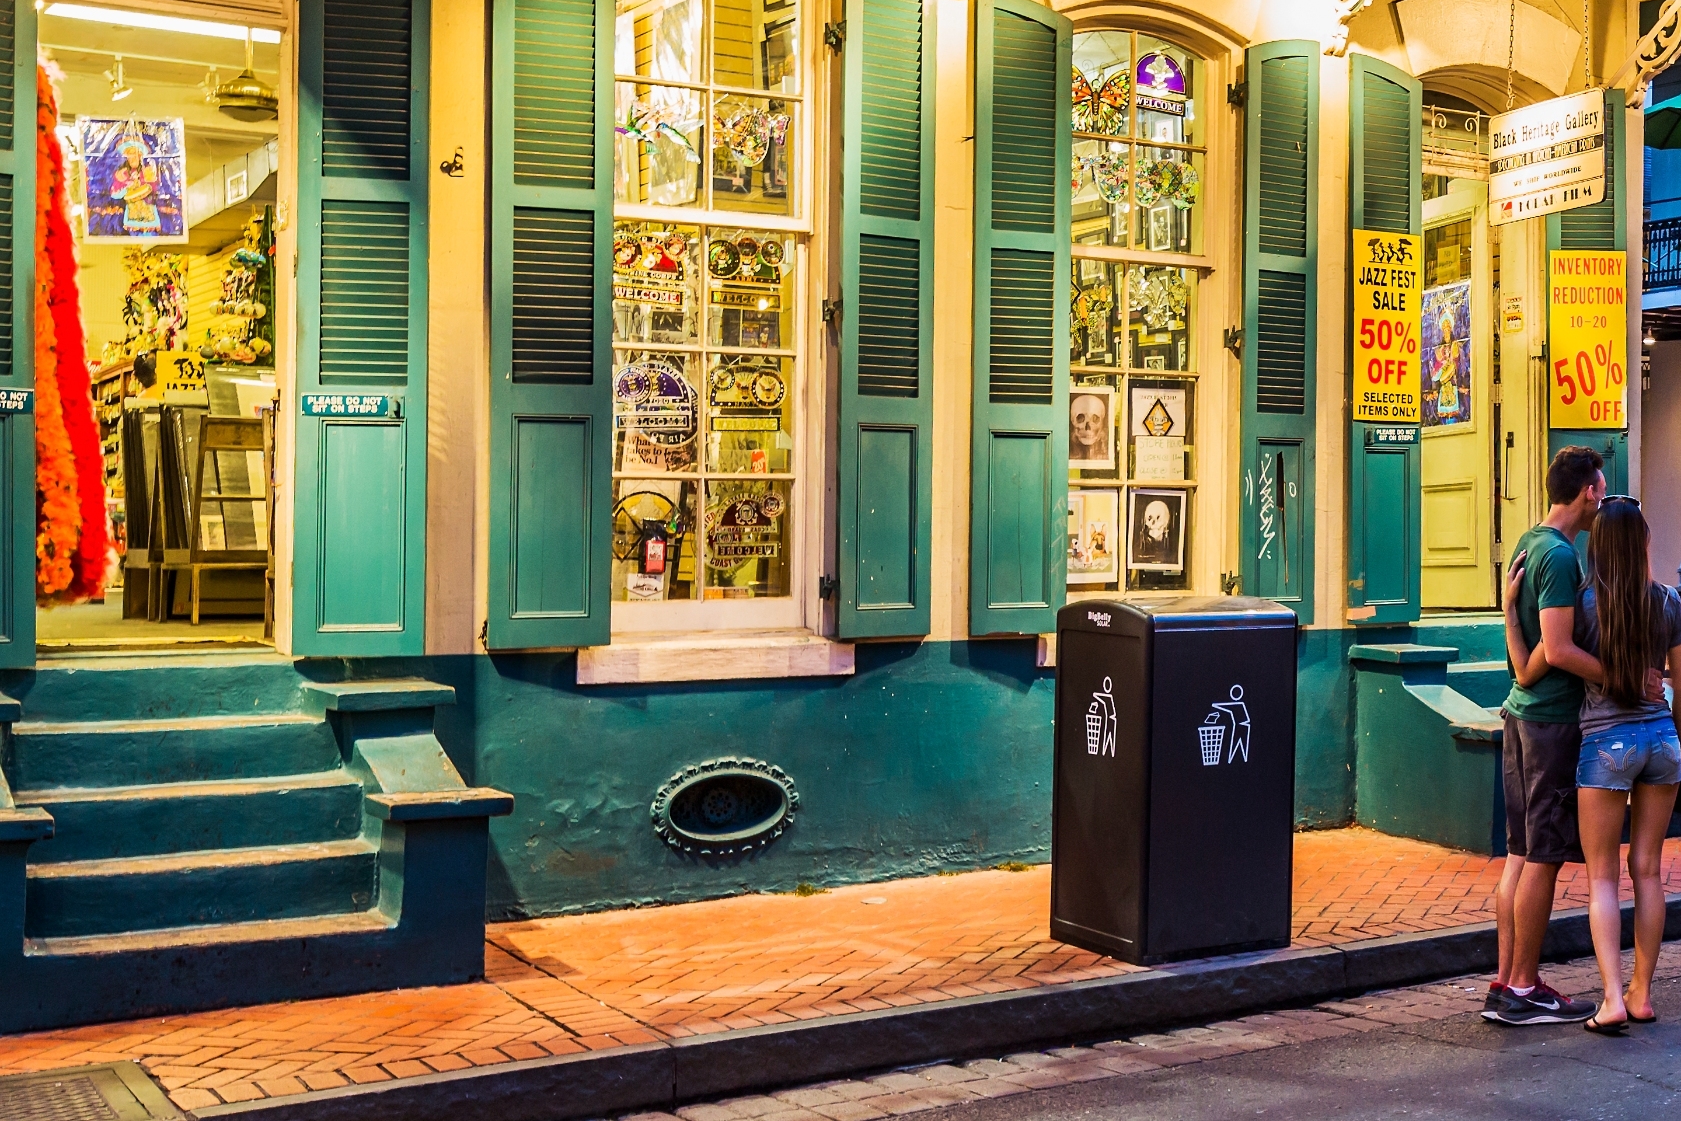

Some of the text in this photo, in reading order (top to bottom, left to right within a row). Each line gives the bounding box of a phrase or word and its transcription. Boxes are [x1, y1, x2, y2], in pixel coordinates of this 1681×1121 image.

[1136, 96, 1183, 113] WELCOME
[1493, 110, 1599, 150] Black Heritage Gallery
[1527, 176, 1540, 185] SHIP
[1544, 166, 1582, 179] WORLDWIDE
[1519, 185, 1592, 212] KODAK FILM
[1553, 257, 1622, 275] INVENTORY
[1359, 267, 1416, 289] JAZZ FEST
[614, 286, 681, 303] WELCOME
[1373, 291, 1406, 311] SALE
[1553, 287, 1623, 305] REDUCTION
[1570, 315, 1607, 328] 10-20
[1359, 319, 1416, 354] 50%
[1368, 358, 1408, 385] OFF
[1554, 340, 1623, 405] 50%
[11, 392, 28, 402] NOT
[307, 396, 383, 406] PLEASE DO NOT
[1363, 392, 1413, 405] SELECTED
[312, 404, 378, 413] SIT ON STEPS
[1358, 405, 1417, 418] ITEMS ONLY
[1590, 401, 1622, 422] OFF
[625, 454, 658, 465] be No.1
[626, 446, 662, 457] takes to
